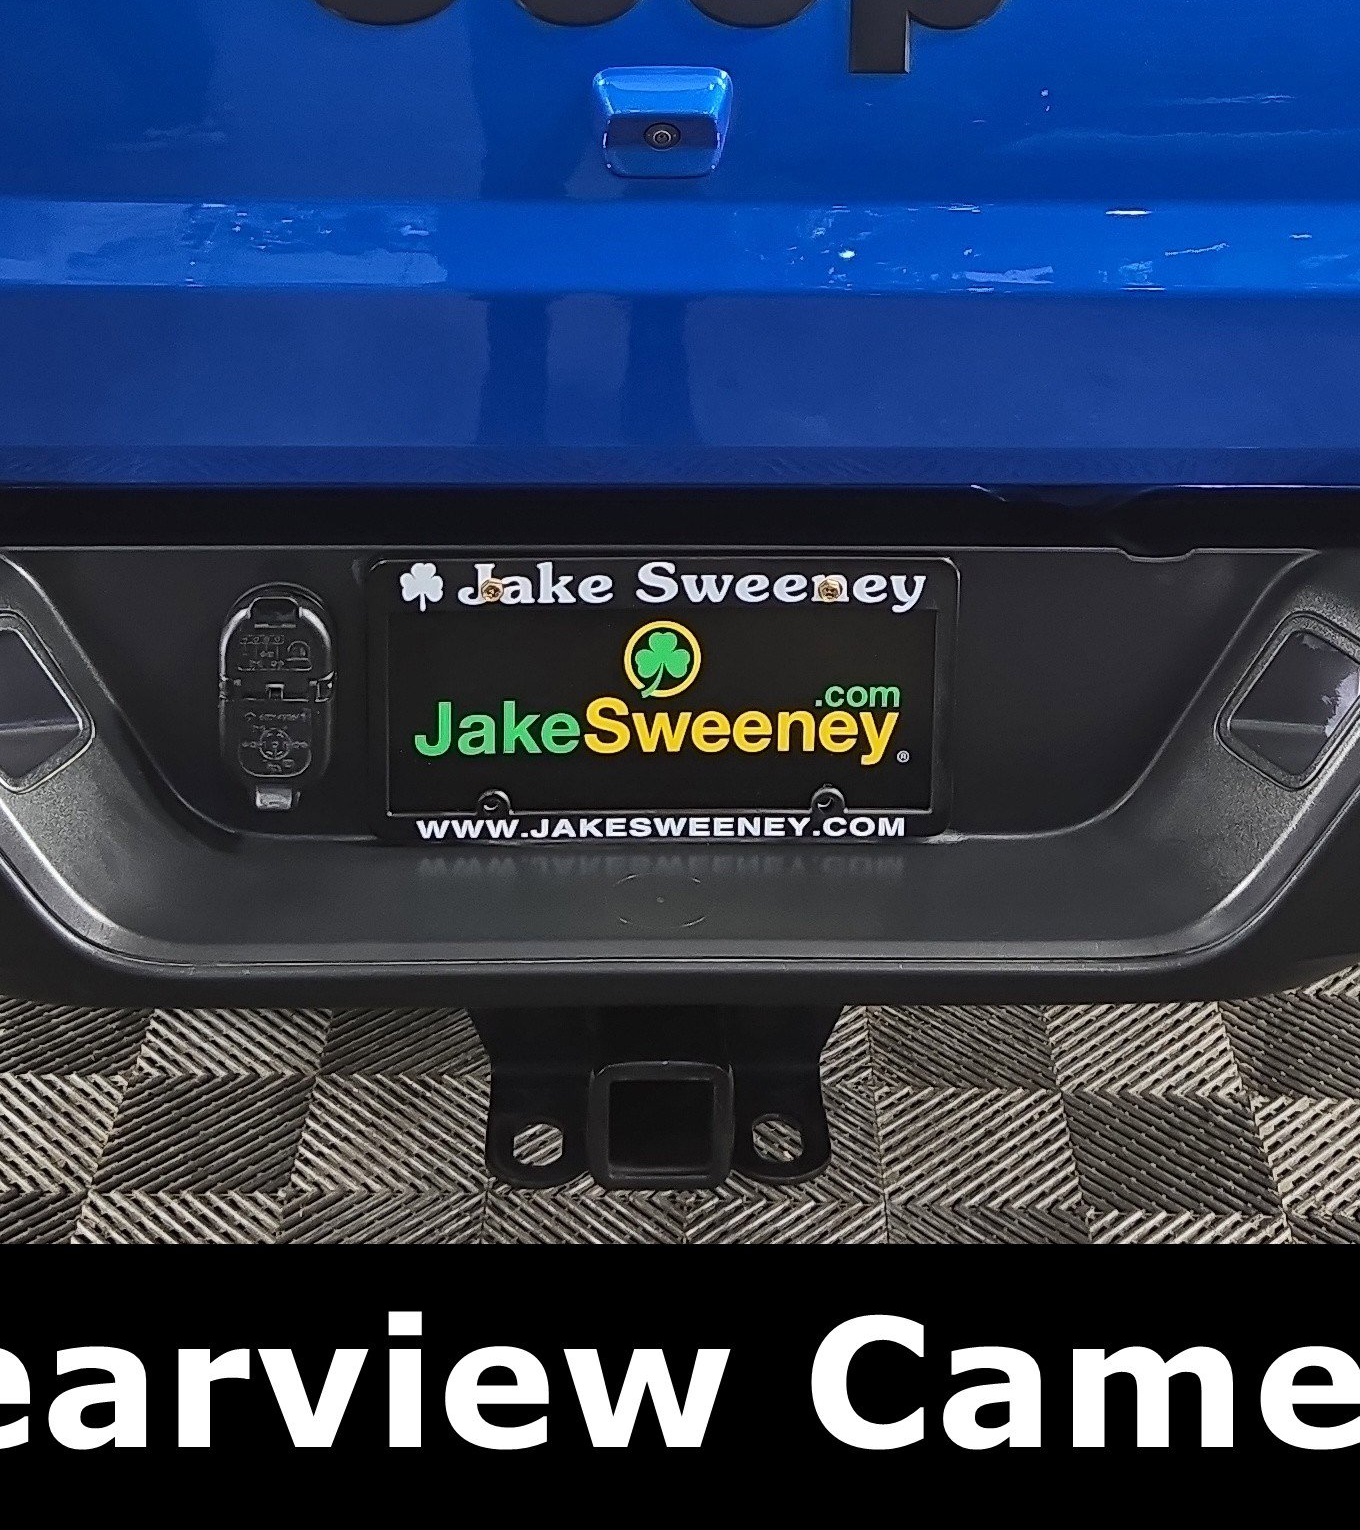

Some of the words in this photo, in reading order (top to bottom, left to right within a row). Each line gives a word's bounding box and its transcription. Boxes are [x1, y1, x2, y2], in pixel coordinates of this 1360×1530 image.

[457, 561, 614, 606] Jake
[635, 561, 927, 613] Sweeney
[815, 686, 900, 708] .com
[416, 816, 906, 839] WWW.JAKESWEENEY.COM
